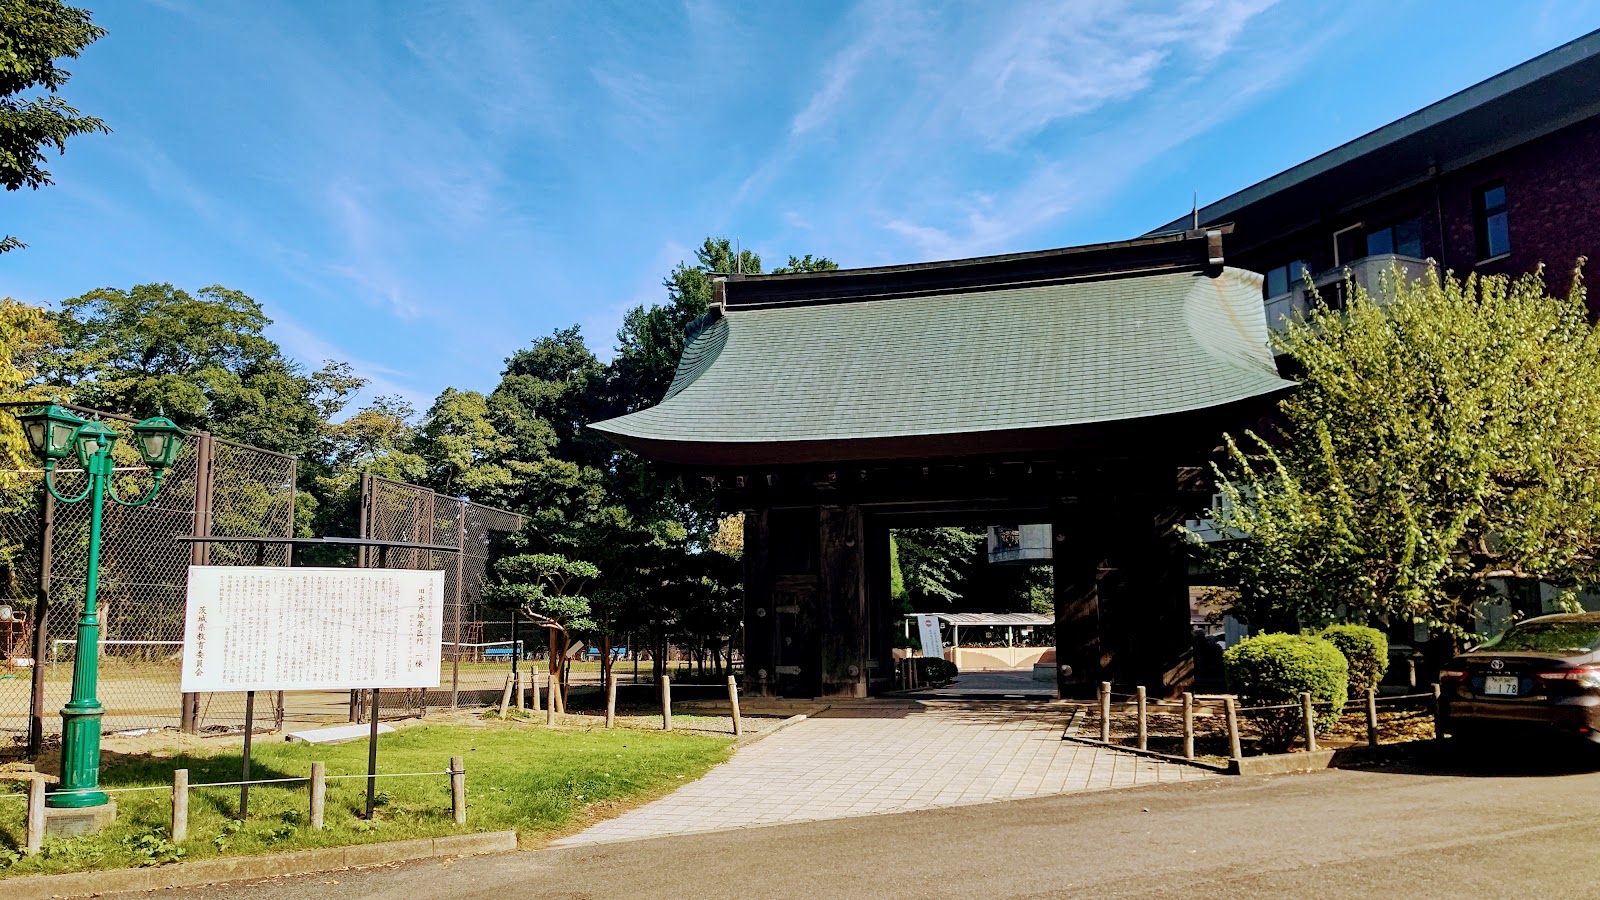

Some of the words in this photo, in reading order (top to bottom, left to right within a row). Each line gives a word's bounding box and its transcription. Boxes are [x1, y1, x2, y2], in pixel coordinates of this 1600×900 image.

[195, 606, 207, 677] 茨城県教育委員会
